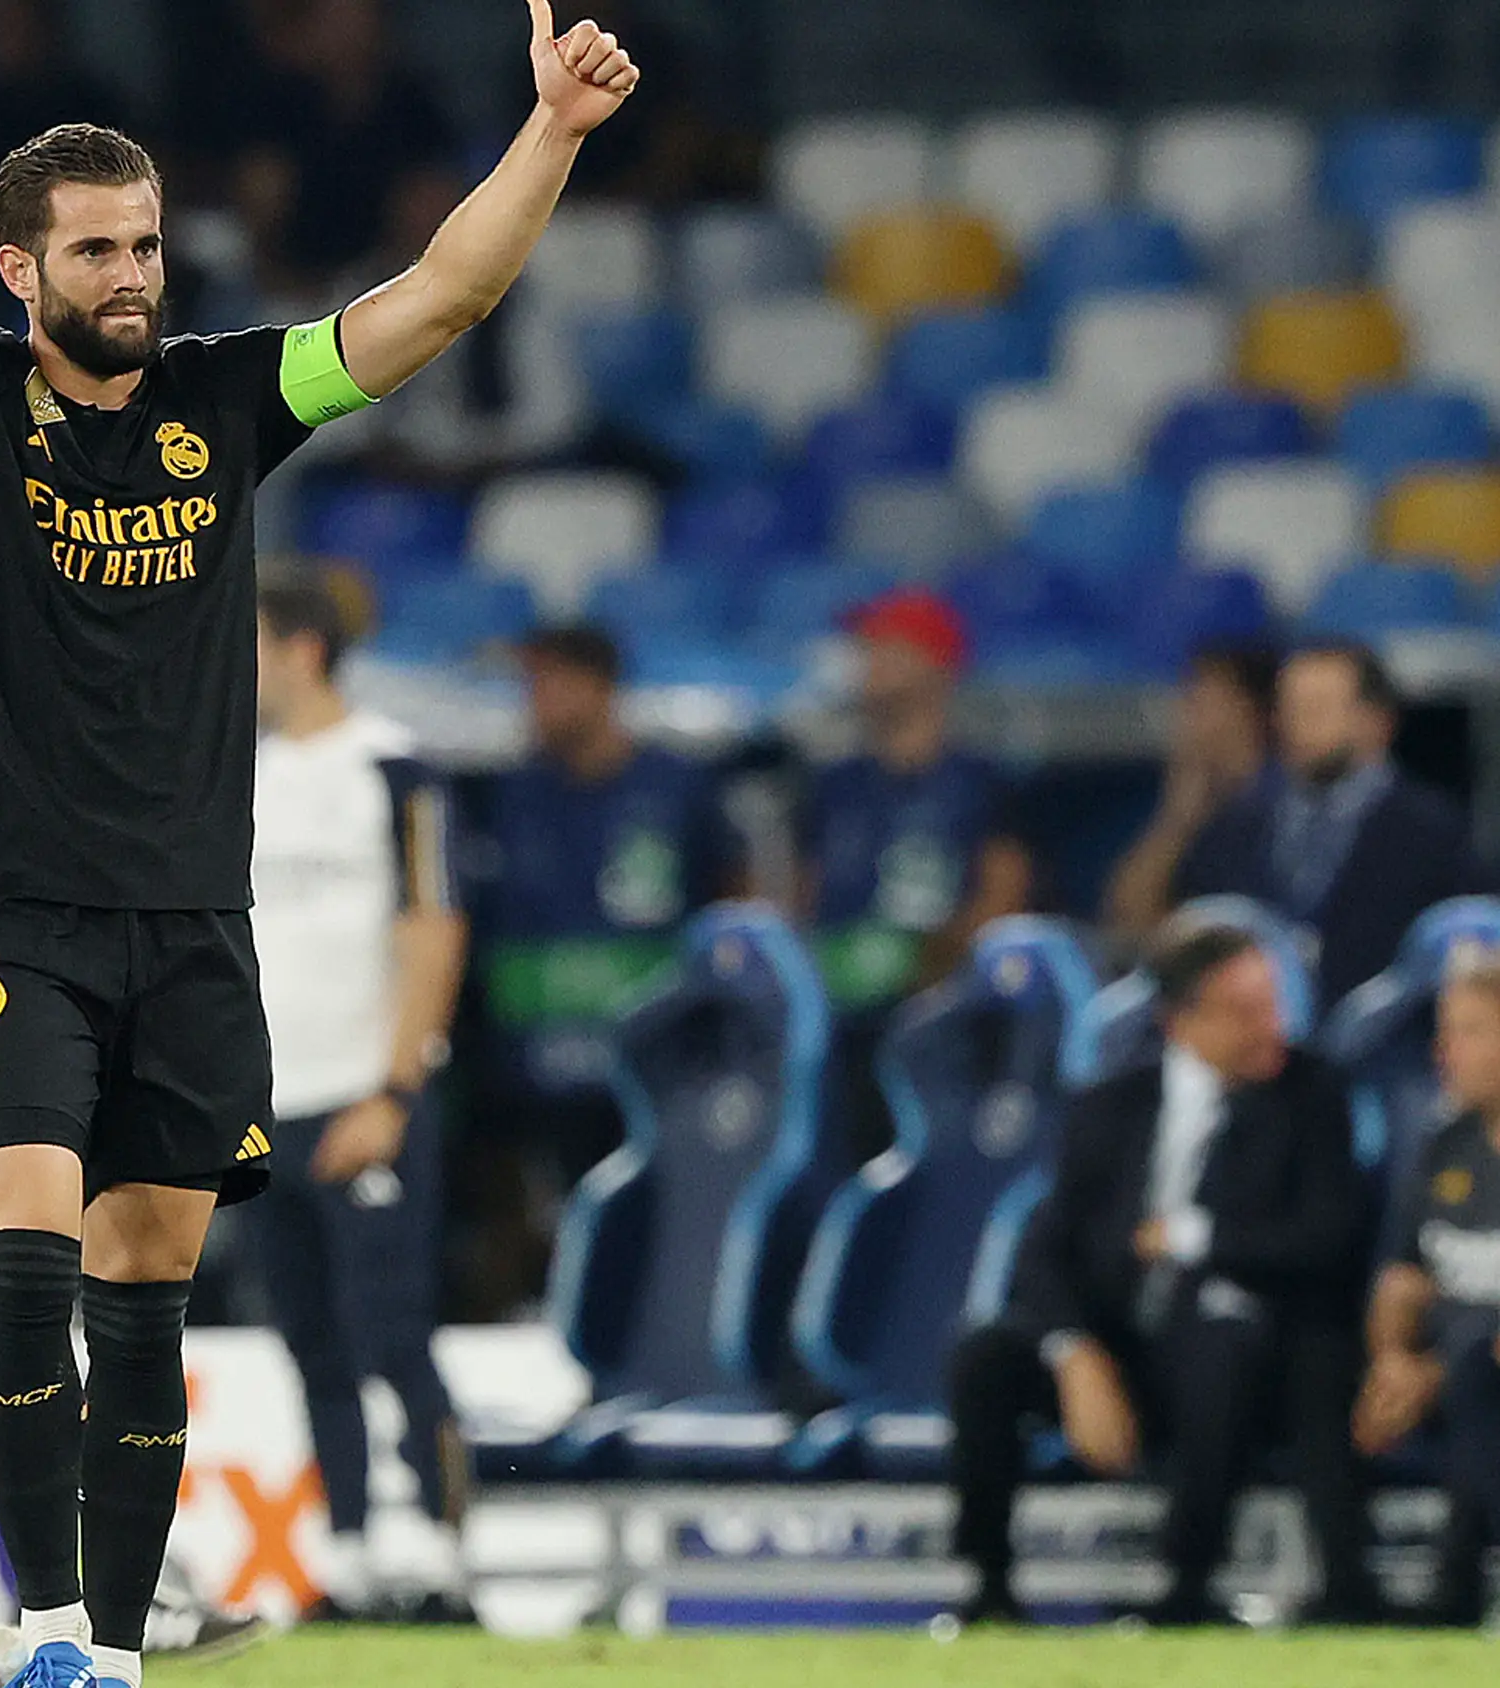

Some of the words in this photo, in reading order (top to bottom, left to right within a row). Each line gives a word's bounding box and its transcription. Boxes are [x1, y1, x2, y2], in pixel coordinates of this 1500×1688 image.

[24, 476, 218, 545] Emirates
[52, 540, 96, 583] FLY
[101, 539, 197, 586] BETTER
[118, 1428, 187, 1447] RMC
